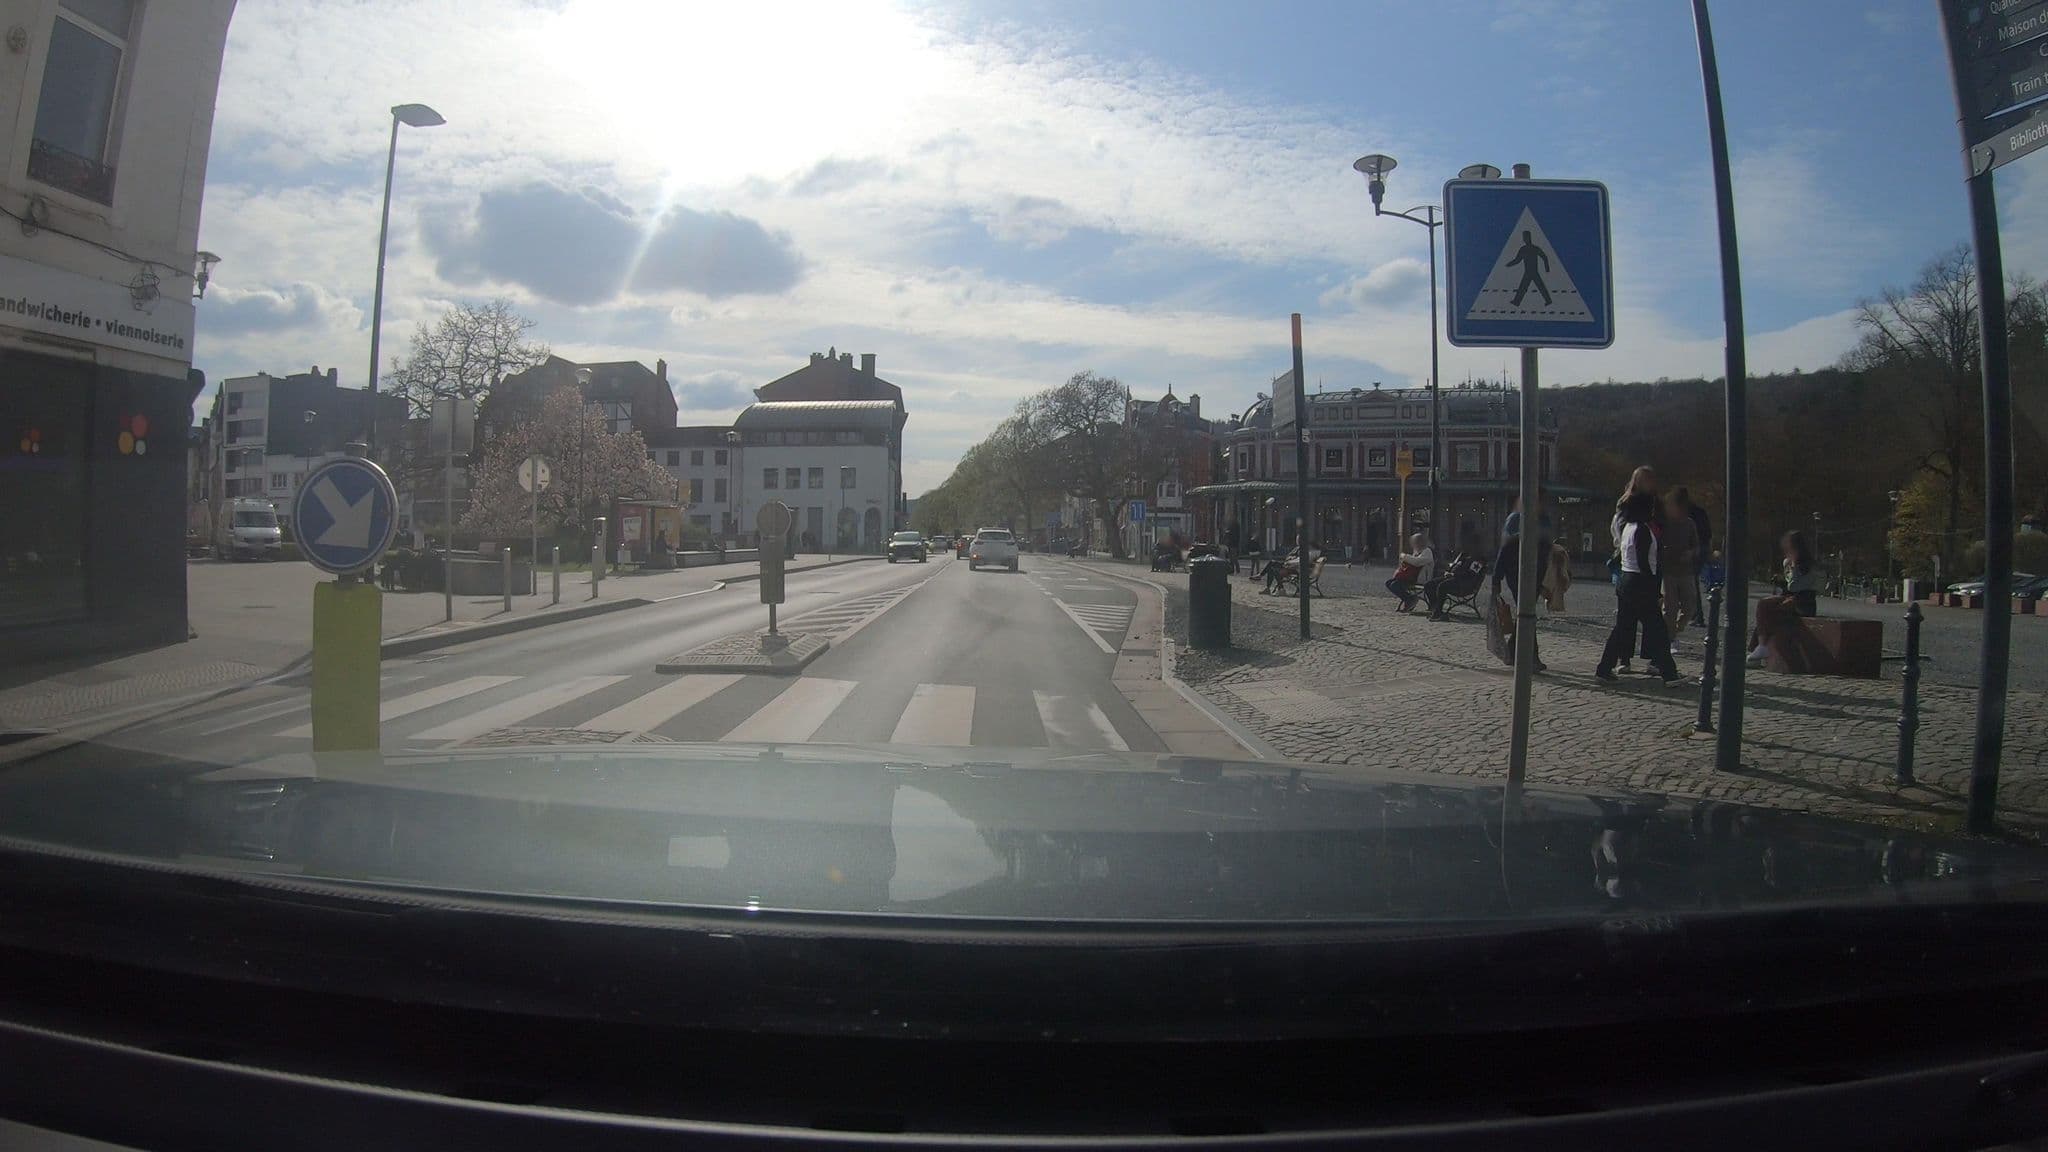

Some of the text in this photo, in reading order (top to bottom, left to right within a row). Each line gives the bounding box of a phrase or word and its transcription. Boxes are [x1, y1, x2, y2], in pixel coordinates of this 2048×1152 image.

[1998, 17, 2037, 41] Maison
[2011, 77, 2042, 96] Train
[105, 319, 185, 350] viennoiserie
